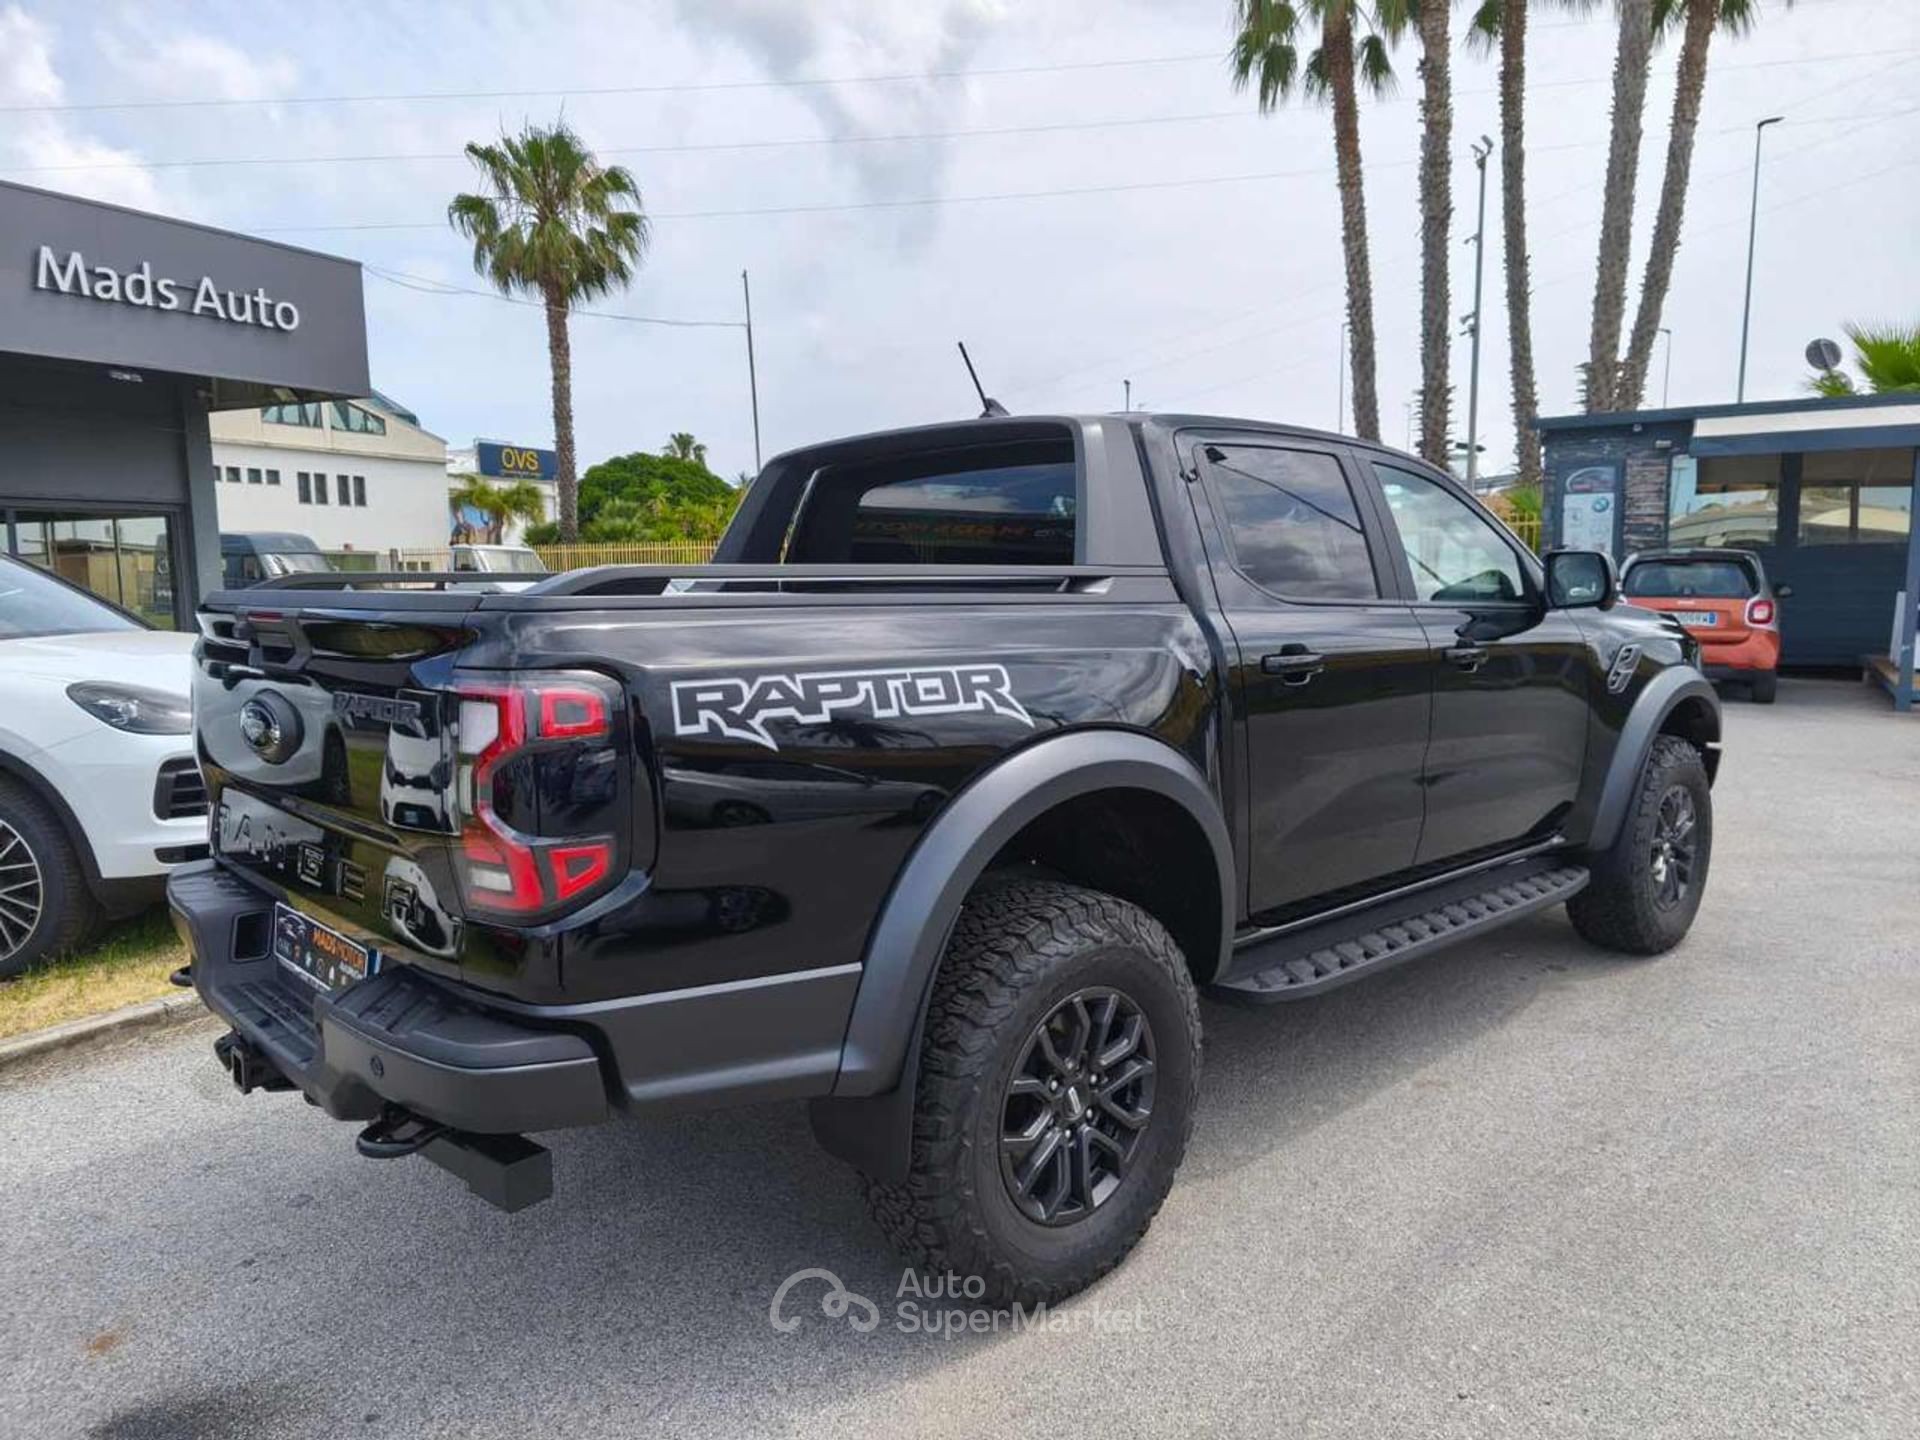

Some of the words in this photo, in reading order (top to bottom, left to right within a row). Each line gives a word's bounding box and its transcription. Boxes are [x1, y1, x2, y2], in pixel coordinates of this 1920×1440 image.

[36, 245, 179, 310] Mads
[192, 276, 300, 331] Auto
[502, 447, 539, 470] OVS
[333, 690, 428, 739] RAPTOR
[670, 663, 1035, 752] RAPTOR
